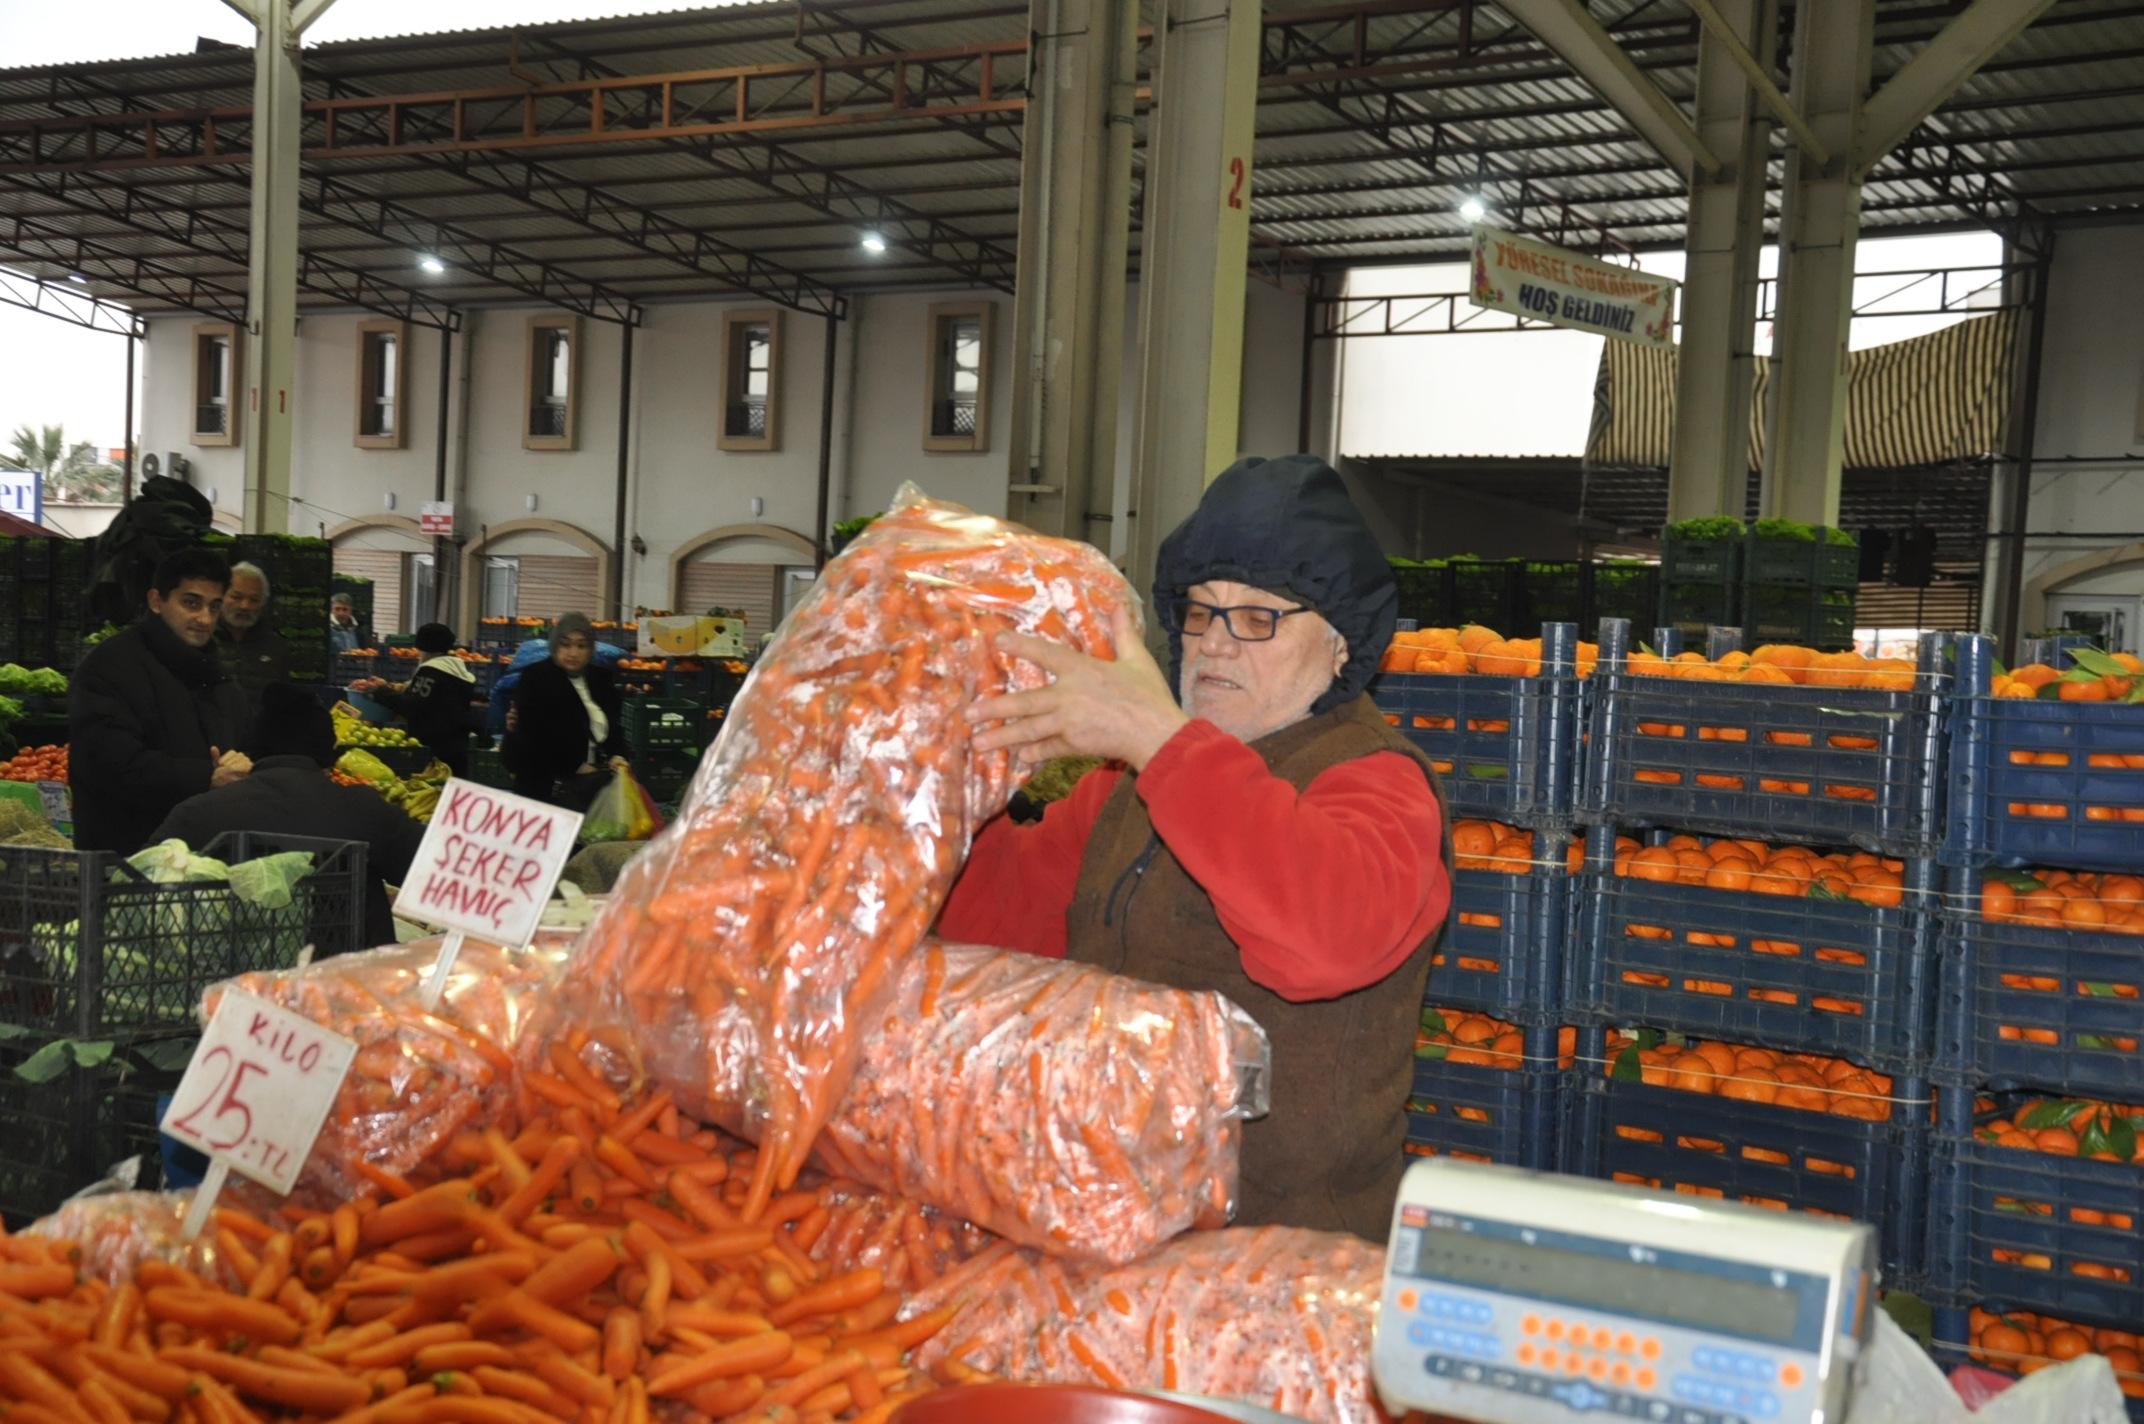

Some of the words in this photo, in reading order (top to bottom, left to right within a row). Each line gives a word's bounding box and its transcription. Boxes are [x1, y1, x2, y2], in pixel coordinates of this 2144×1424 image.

[1228, 156, 1244, 210] 2
[1494, 240, 1570, 285] YÖRESEL
[1519, 283, 1558, 319] HOŞ
[1562, 295, 1635, 334] GELDİNİZ
[251, 387, 258, 412] 1
[279, 389, 287, 414] 1
[442, 786, 552, 851] KONYA
